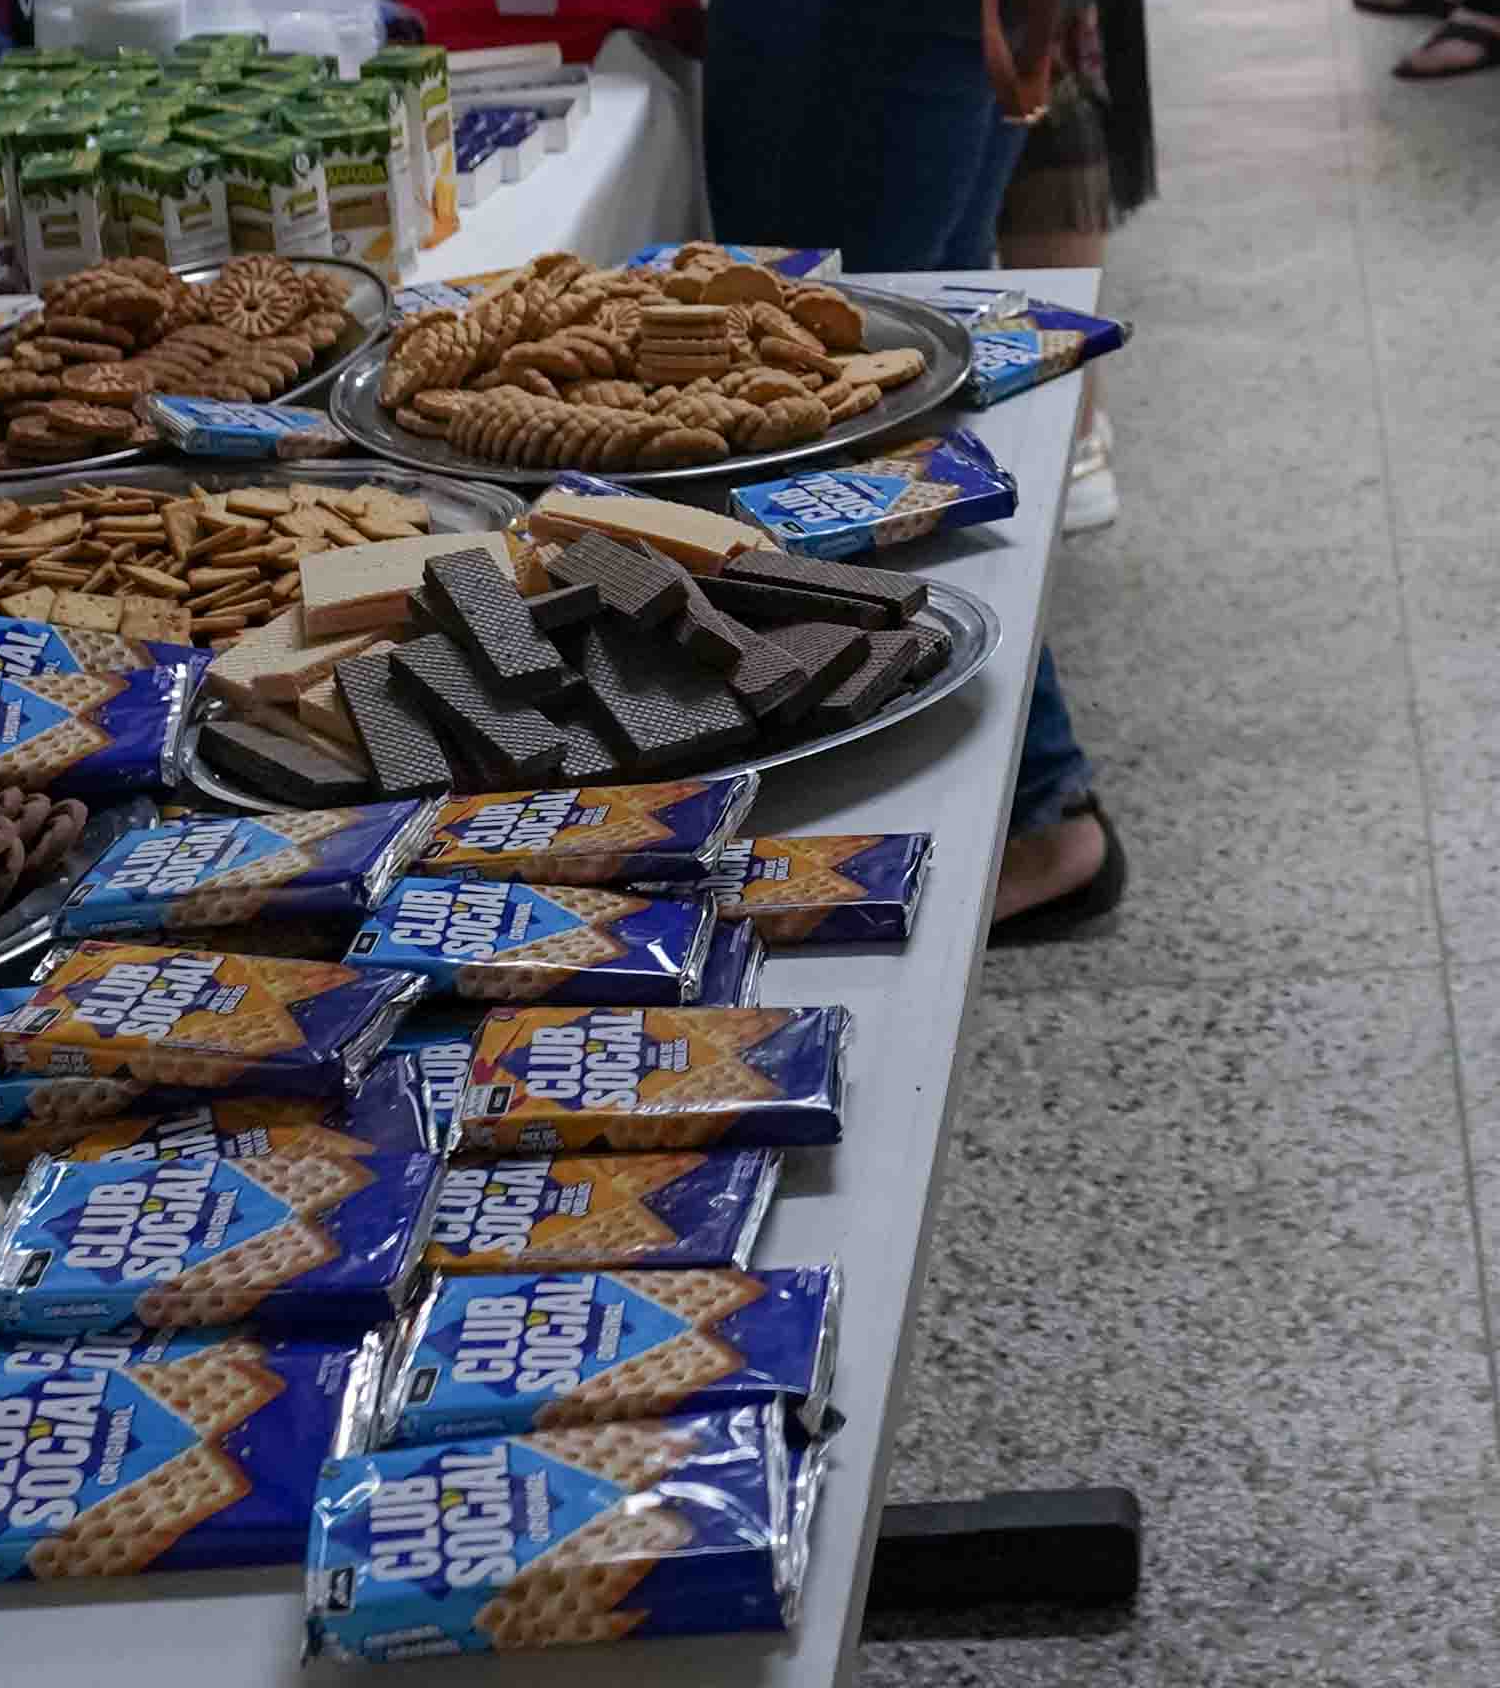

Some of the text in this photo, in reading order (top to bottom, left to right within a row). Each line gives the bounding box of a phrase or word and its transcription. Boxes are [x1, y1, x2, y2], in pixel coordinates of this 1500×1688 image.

[458, 801, 527, 849] CLUB
[501, 789, 582, 851] SOCIAL
[105, 835, 183, 890] CLUB
[390, 889, 454, 947] CLUB
[441, 882, 512, 961] SOCIAL
[71, 961, 161, 1026] CLUB
[115, 953, 227, 1040] SOCIAL
[525, 1025, 587, 1100] CLUB
[581, 1008, 646, 1110] SOCIAL
[66, 1181, 151, 1270] CLUB
[122, 1160, 219, 1283] SOCIAL
[200, 1189, 241, 1250] ORIGINAL
[432, 1168, 489, 1244] CLUB
[468, 1158, 553, 1258] SOCIAL
[452, 1295, 529, 1385] CLUB
[515, 1274, 599, 1397] SOCIAL
[595, 1300, 628, 1361] ORIGINAL
[8, 1371, 112, 1531] SOCIAL
[96, 1405, 138, 1486] ORIGINAL
[369, 1476, 441, 1583] CLUB
[445, 1444, 518, 1589] SOCIAL
[526, 1470, 553, 1543] ORIGINAL
